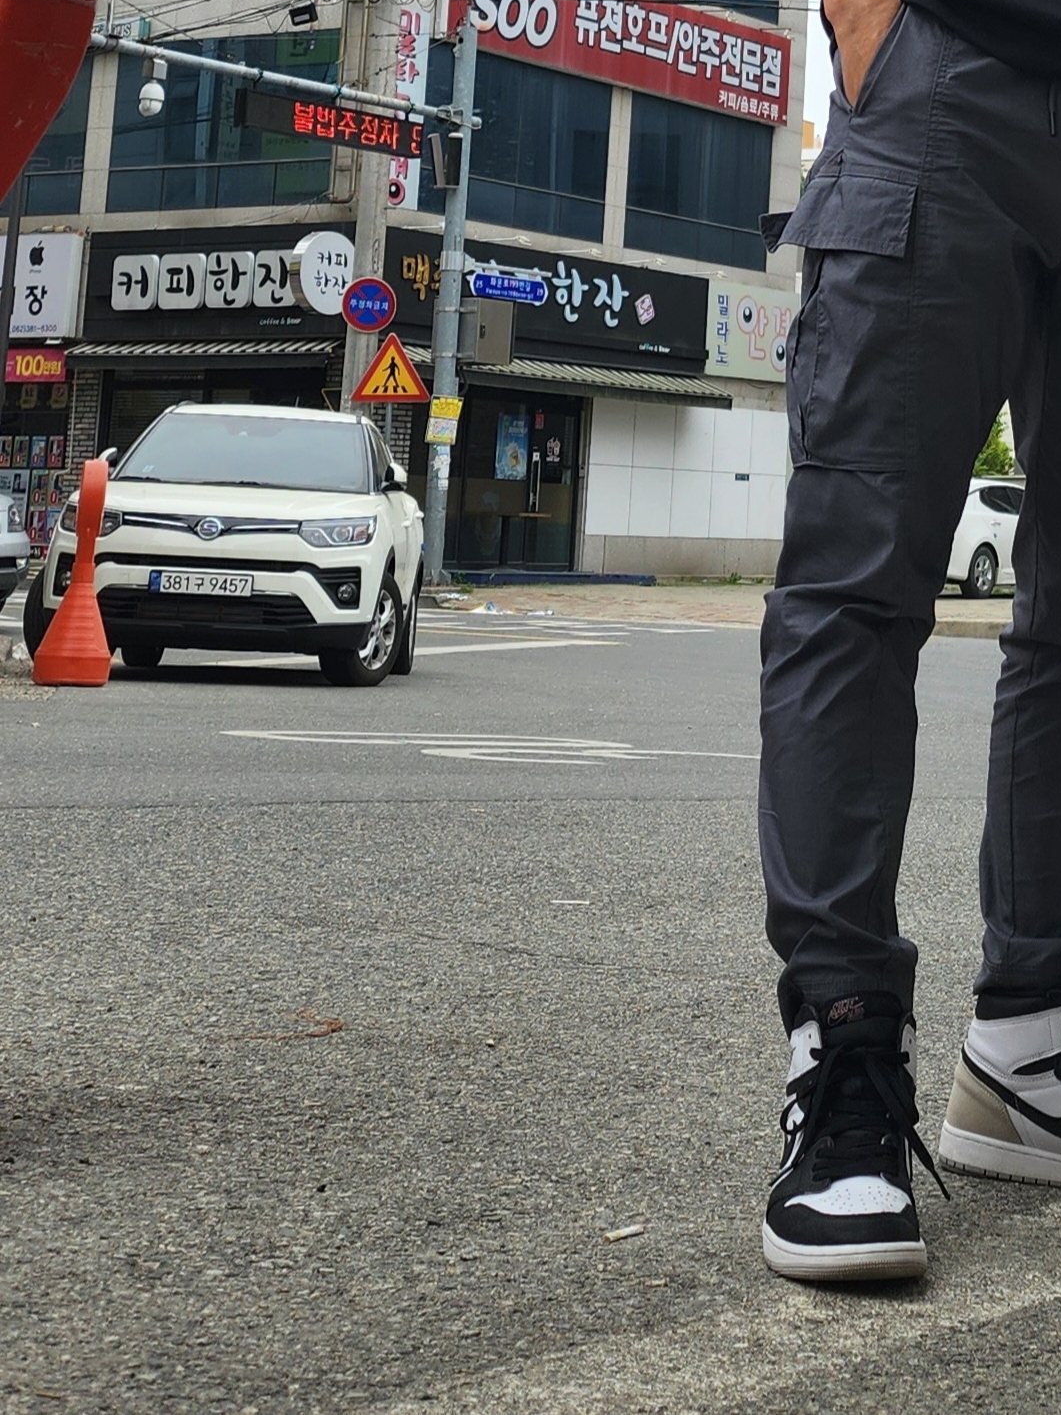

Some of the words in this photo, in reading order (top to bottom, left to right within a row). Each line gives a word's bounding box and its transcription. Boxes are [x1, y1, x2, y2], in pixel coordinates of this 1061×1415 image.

[293, 101, 399, 150] 불법주정차
[316, 250, 348, 268] 커피
[117, 247, 290, 305] 커피한잔
[314, 269, 349, 296] 한잔
[162, 575, 205, 592] 381구
[209, 577, 249, 594] 9457
